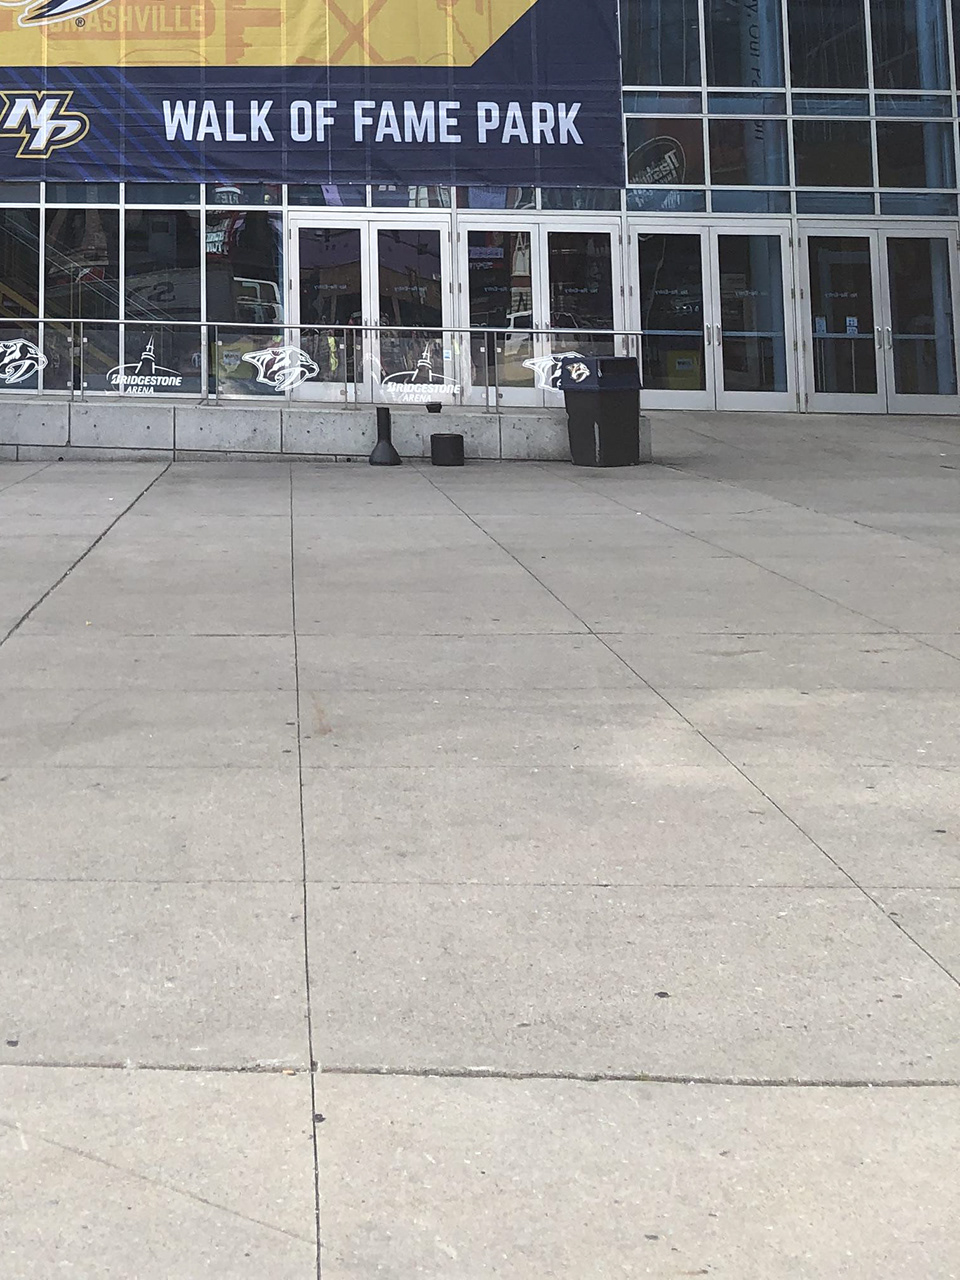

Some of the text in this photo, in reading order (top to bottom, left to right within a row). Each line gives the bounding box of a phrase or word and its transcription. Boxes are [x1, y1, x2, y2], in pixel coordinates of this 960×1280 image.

[162, 99, 585, 145] WALK OF FAME PARK
[110, 373, 183, 386] BRIDGESTONE
[125, 386, 155, 395] ARENA
[386, 381, 461, 394] BRIDGESTONE
[402, 393, 433, 402] ARENA
